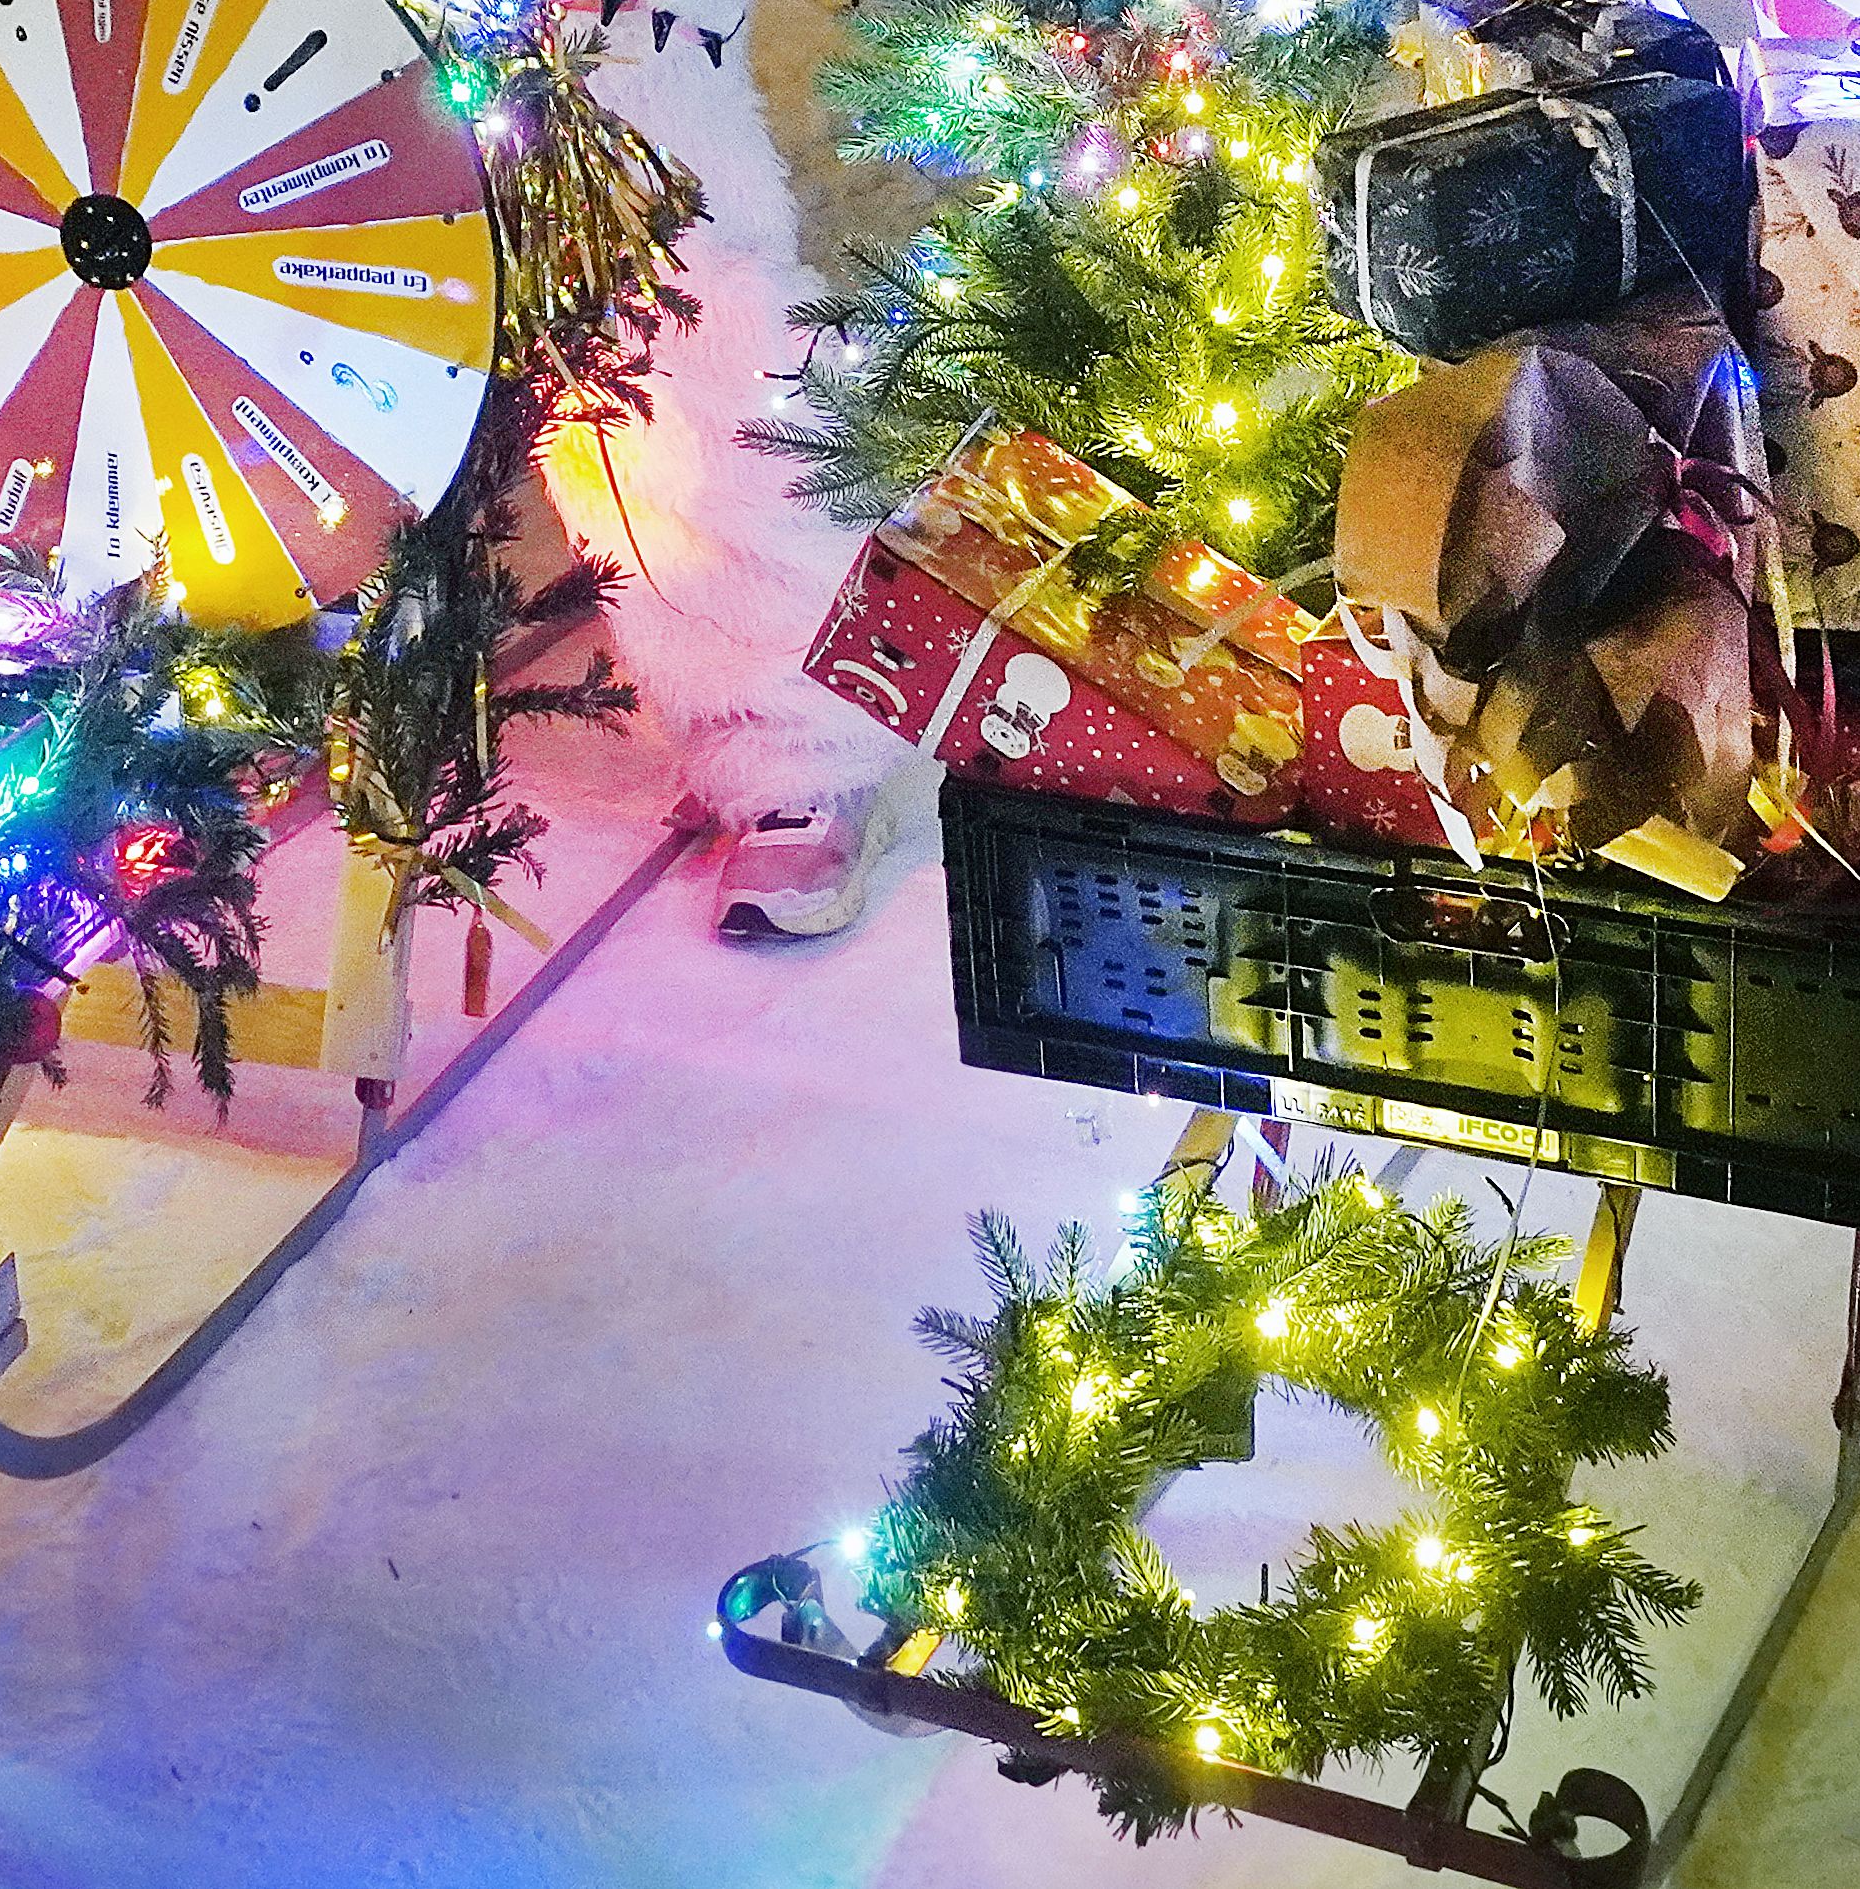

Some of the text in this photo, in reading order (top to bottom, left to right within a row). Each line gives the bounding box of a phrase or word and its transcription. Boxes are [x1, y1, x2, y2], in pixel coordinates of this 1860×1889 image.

[167, 20, 201, 86] nissen
[242, 153, 361, 207] komplimenter
[279, 261, 427, 293] En pepperkake
[236, 399, 321, 495] kompliment
[105, 452, 119, 530] klemmer
[1458, 1117, 1518, 1143] IFCO
